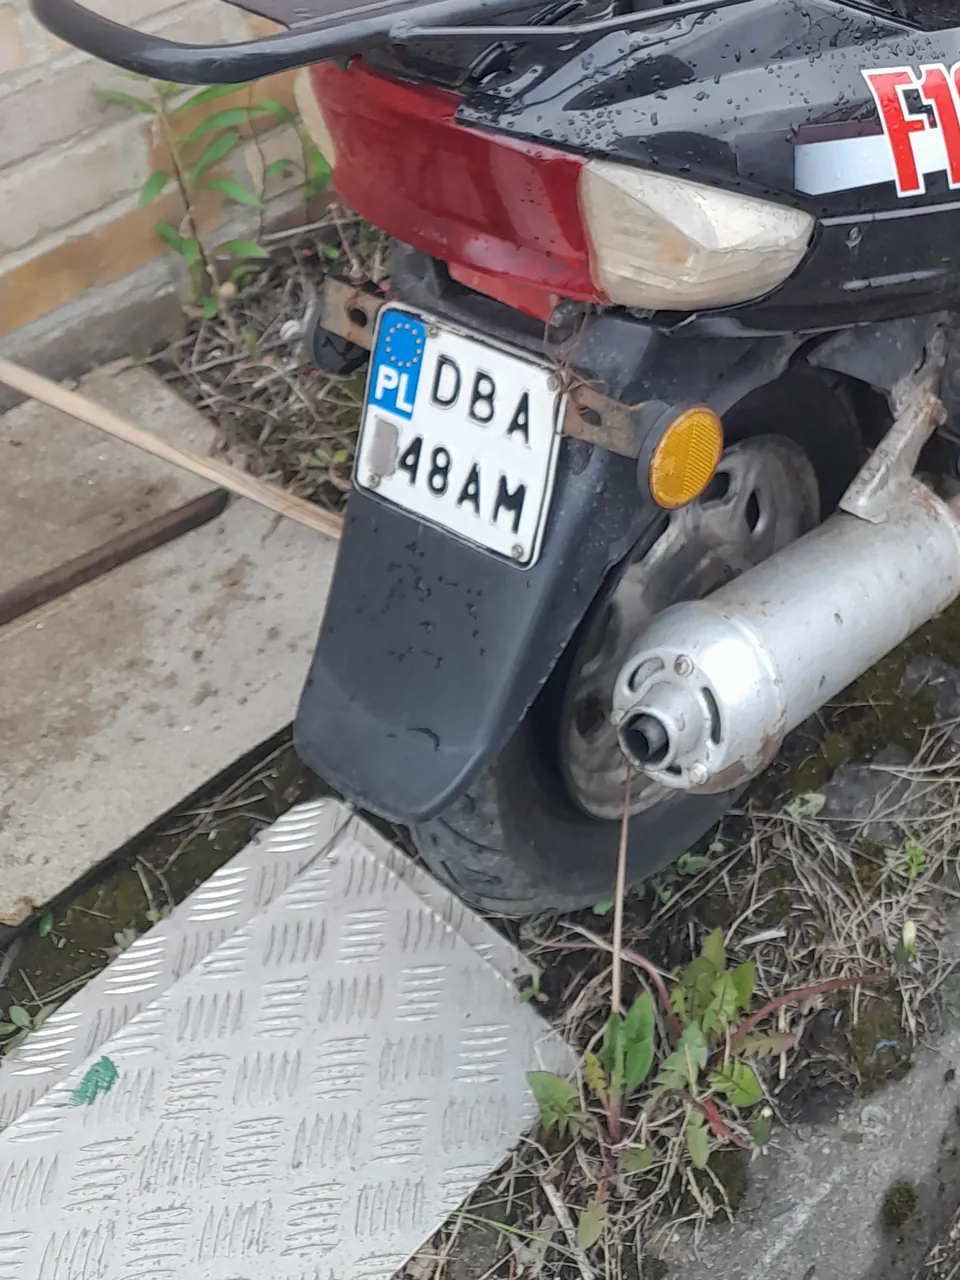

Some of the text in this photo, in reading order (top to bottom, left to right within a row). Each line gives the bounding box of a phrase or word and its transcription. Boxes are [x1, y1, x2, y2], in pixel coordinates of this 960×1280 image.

[375, 365, 412, 413] PL
[431, 354, 531, 447] DBA
[399, 437, 527, 533] 48AM
